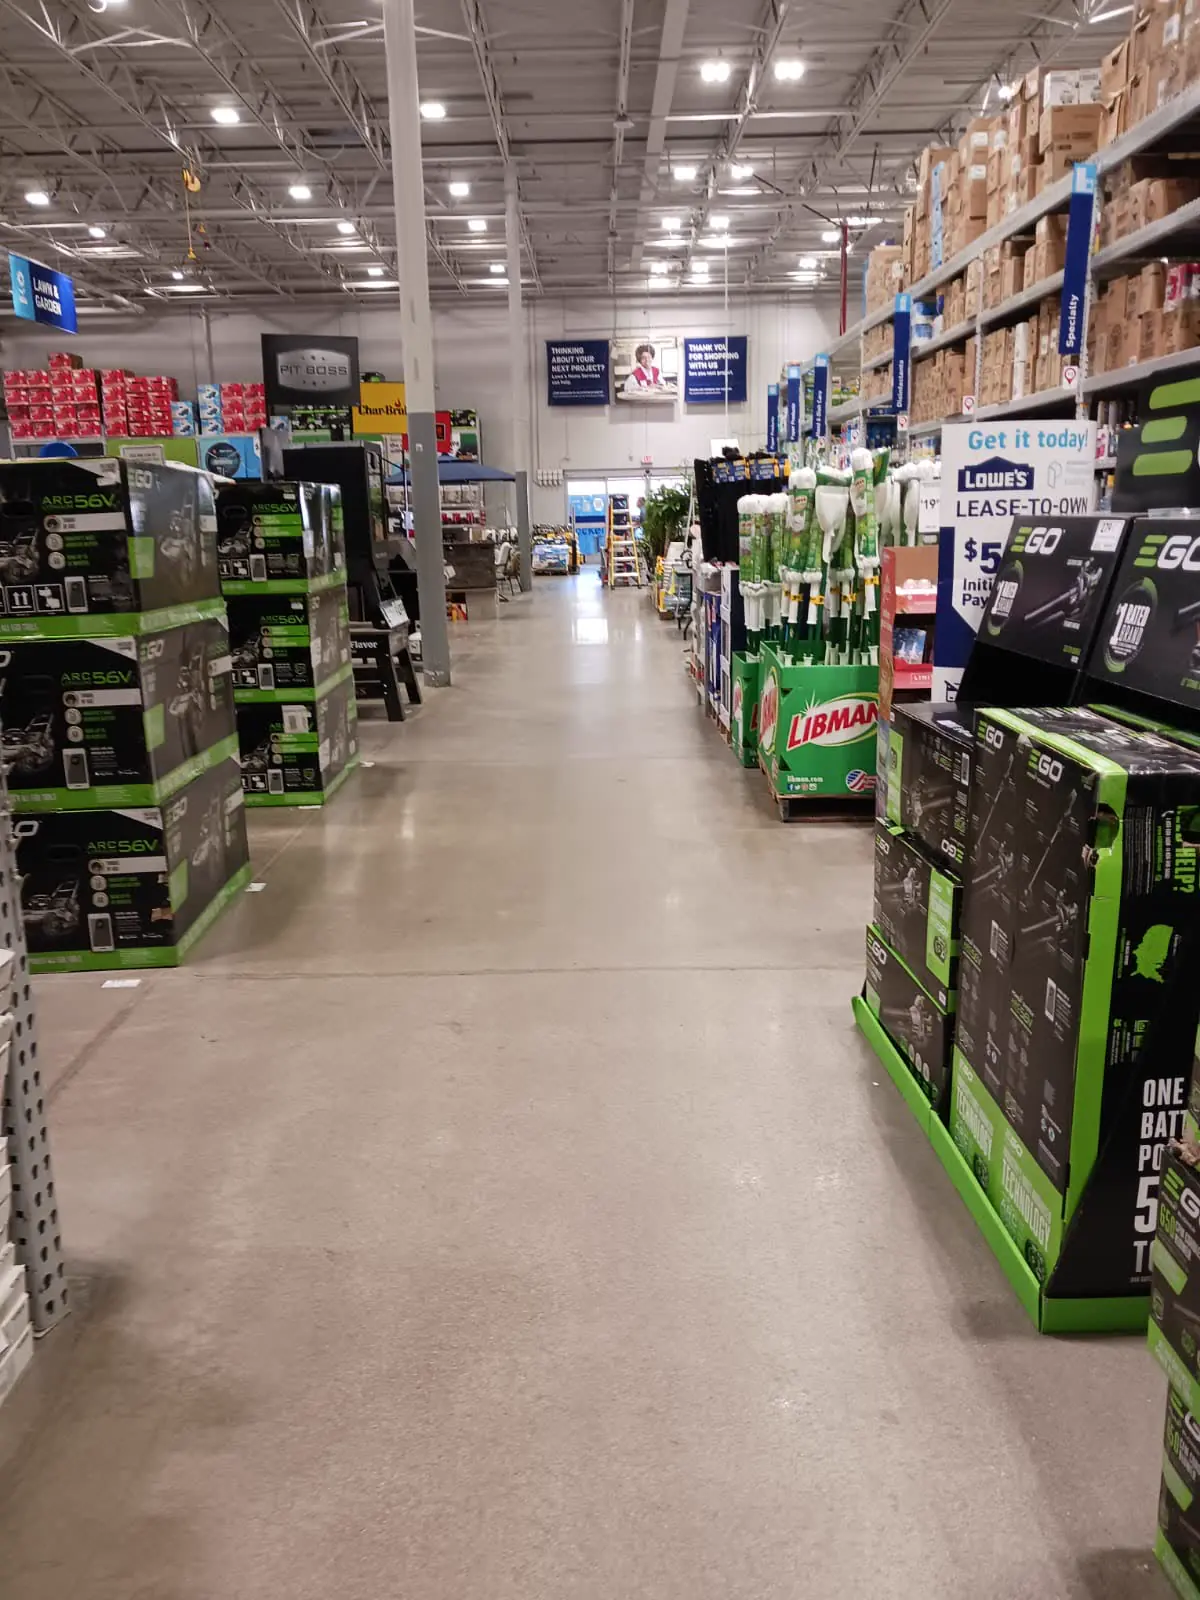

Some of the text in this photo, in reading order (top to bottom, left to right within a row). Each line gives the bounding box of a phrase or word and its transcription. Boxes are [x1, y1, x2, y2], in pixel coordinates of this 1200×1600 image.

[33, 277, 59, 299] LAWN &
[36, 295, 62, 316] GARDEN
[1066, 294, 1080, 348] Specialty
[551, 347, 584, 355] THINKING
[576, 355, 595, 363] YOUR
[688, 344, 712, 352] THANK
[704, 352, 739, 361] SHOPPNG
[280, 364, 348, 376] PIT BOSS
[571, 364, 605, 372] PROJECT?
[896, 360, 905, 408] Disinfectants
[968, 428, 1089, 452] Get it today!
[964, 469, 1029, 489] LOWE'S
[75, 493, 116, 508] 56V
[956, 497, 1088, 517] LEASE-TO-OWN
[1010, 527, 1063, 555] EGO
[963, 578, 993, 591] Initi
[61, 671, 132, 684] ARC 56V
[787, 701, 879, 751] LIBMAN
[977, 720, 1004, 749] EGO
[1028, 749, 1063, 783] EGO
[87, 839, 158, 853] ARC 56V
[1173, 848, 1197, 894] HELP?
[867, 933, 887, 965] EGO
[1143, 1077, 1185, 1107] ONE
[1140, 1109, 1188, 1139] BATT
[1002, 1158, 1052, 1253] TECHNOLOGY
[1159, 1203, 1177, 1239] 650
